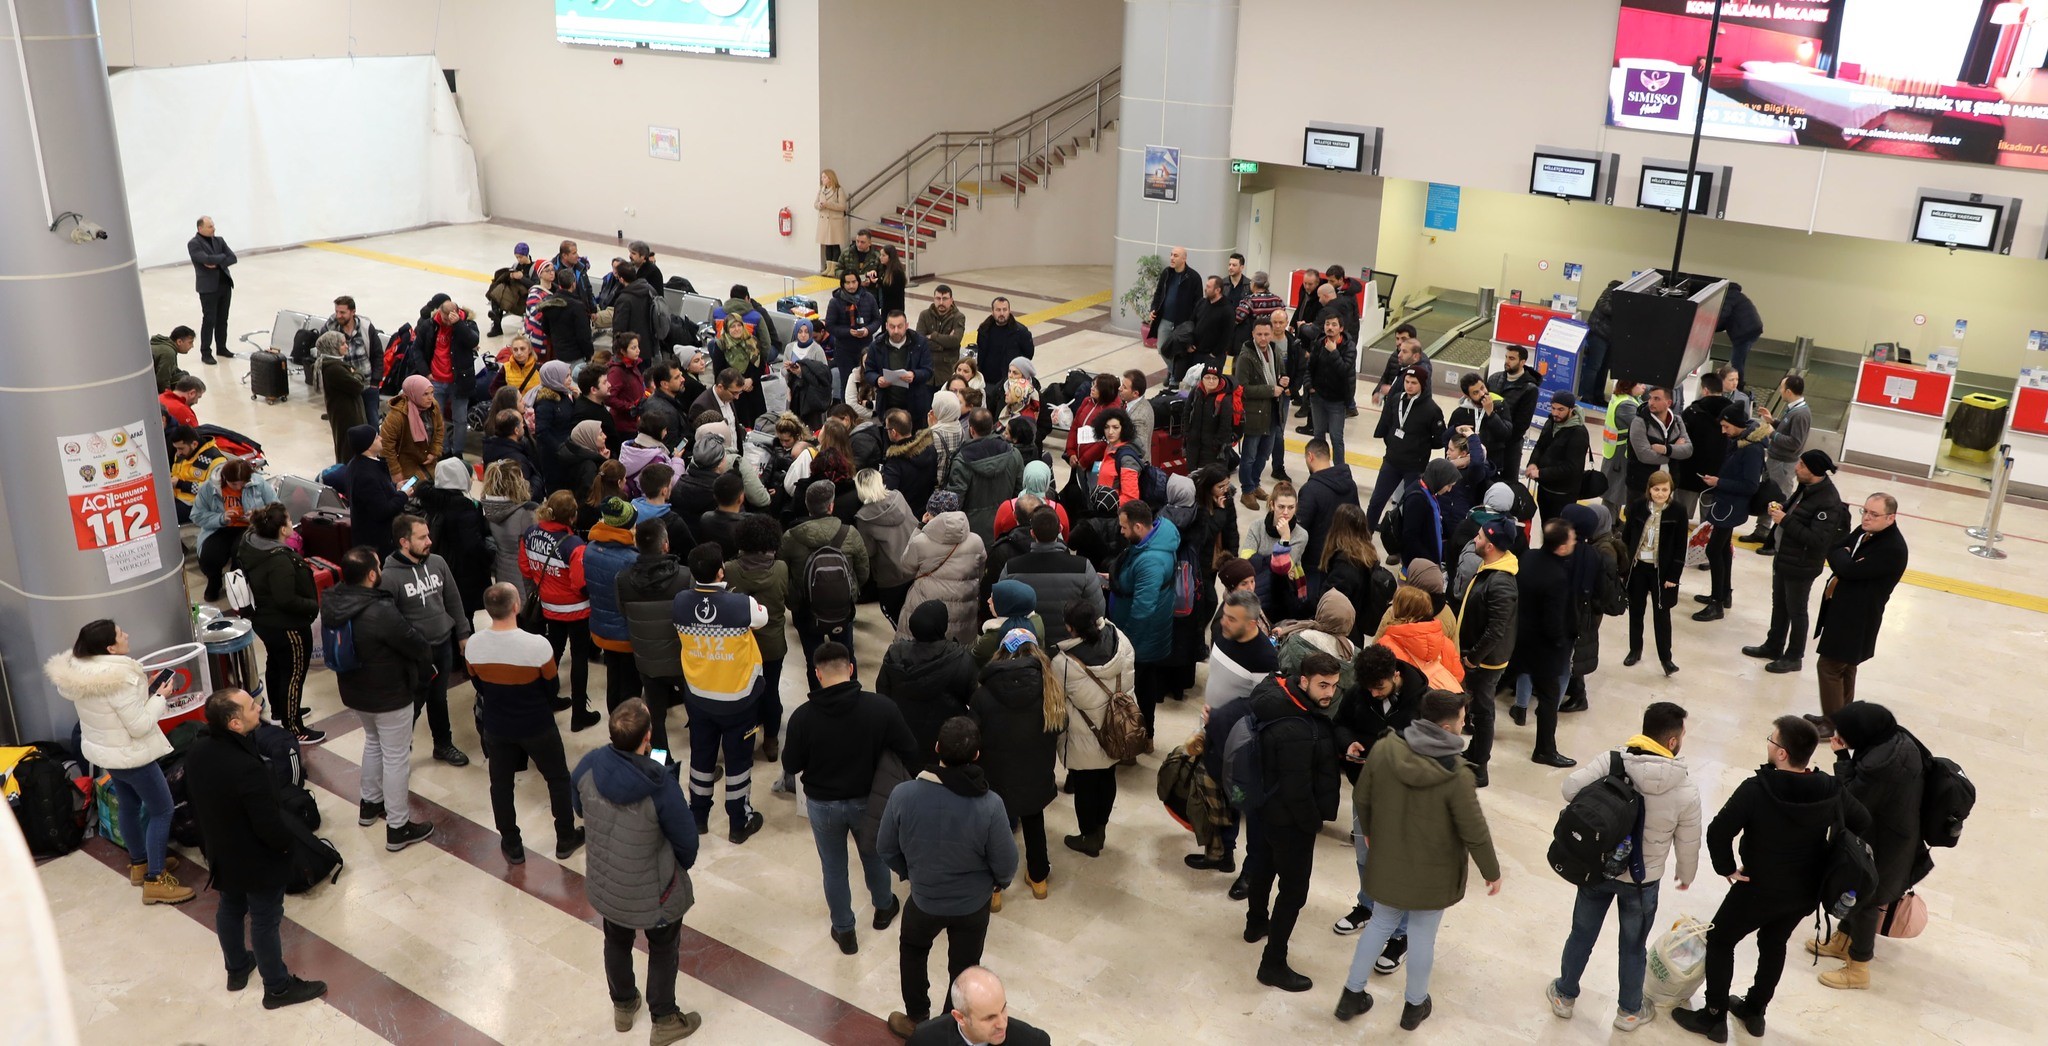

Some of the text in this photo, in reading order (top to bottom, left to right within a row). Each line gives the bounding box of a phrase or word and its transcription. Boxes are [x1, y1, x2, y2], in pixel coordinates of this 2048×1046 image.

[1627, 91, 1678, 105] SIMISSO
[1751, 103, 1761, 111] ve
[1764, 103, 1784, 114] Bilgi
[1955, 100, 1973, 113] VE
[1778, 115, 1790, 128] 11
[1792, 117, 1808, 130] 31
[1718, 211, 1723, 219] 3
[114, 485, 148, 501] DURUMDA
[123, 495, 143, 505] SADECE
[86, 503, 152, 547] 112
[531, 537, 552, 555] UMKE
[693, 635, 725, 651] 112
